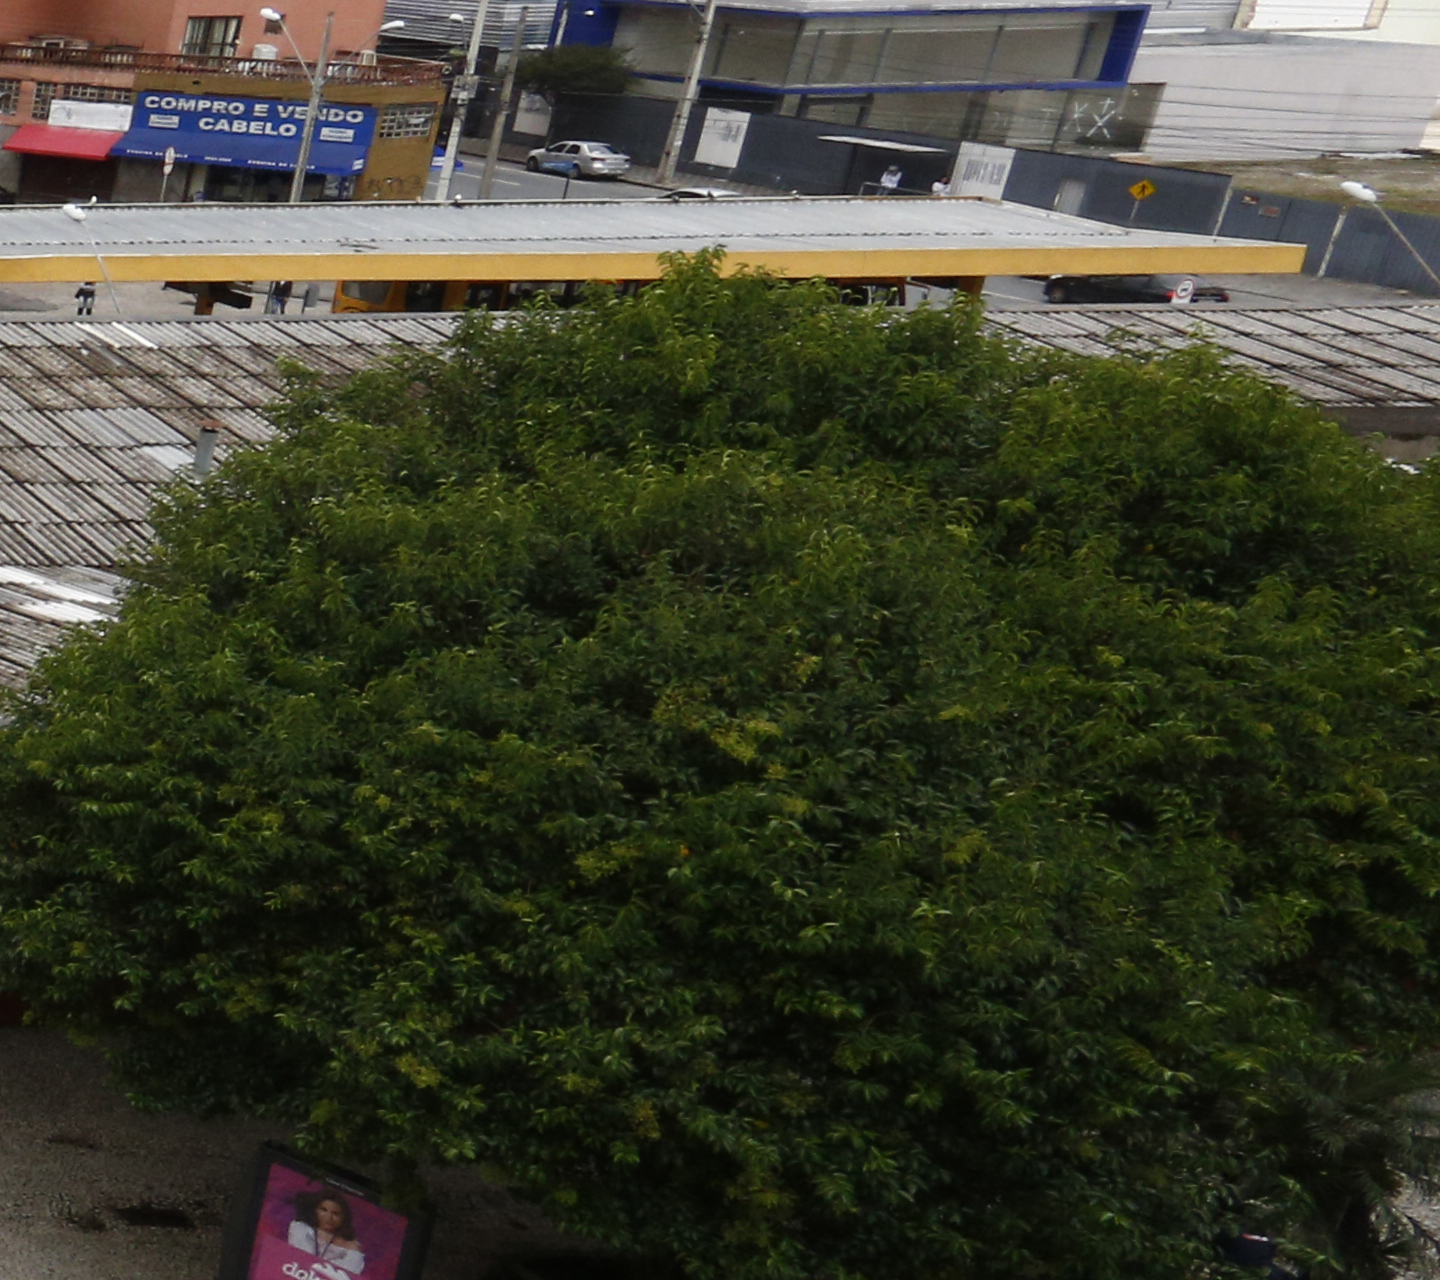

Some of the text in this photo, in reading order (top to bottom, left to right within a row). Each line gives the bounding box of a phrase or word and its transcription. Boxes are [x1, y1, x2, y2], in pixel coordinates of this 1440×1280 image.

[144, 96, 364, 123] COMPRO E VENDO
[198, 117, 297, 136] CABELO
